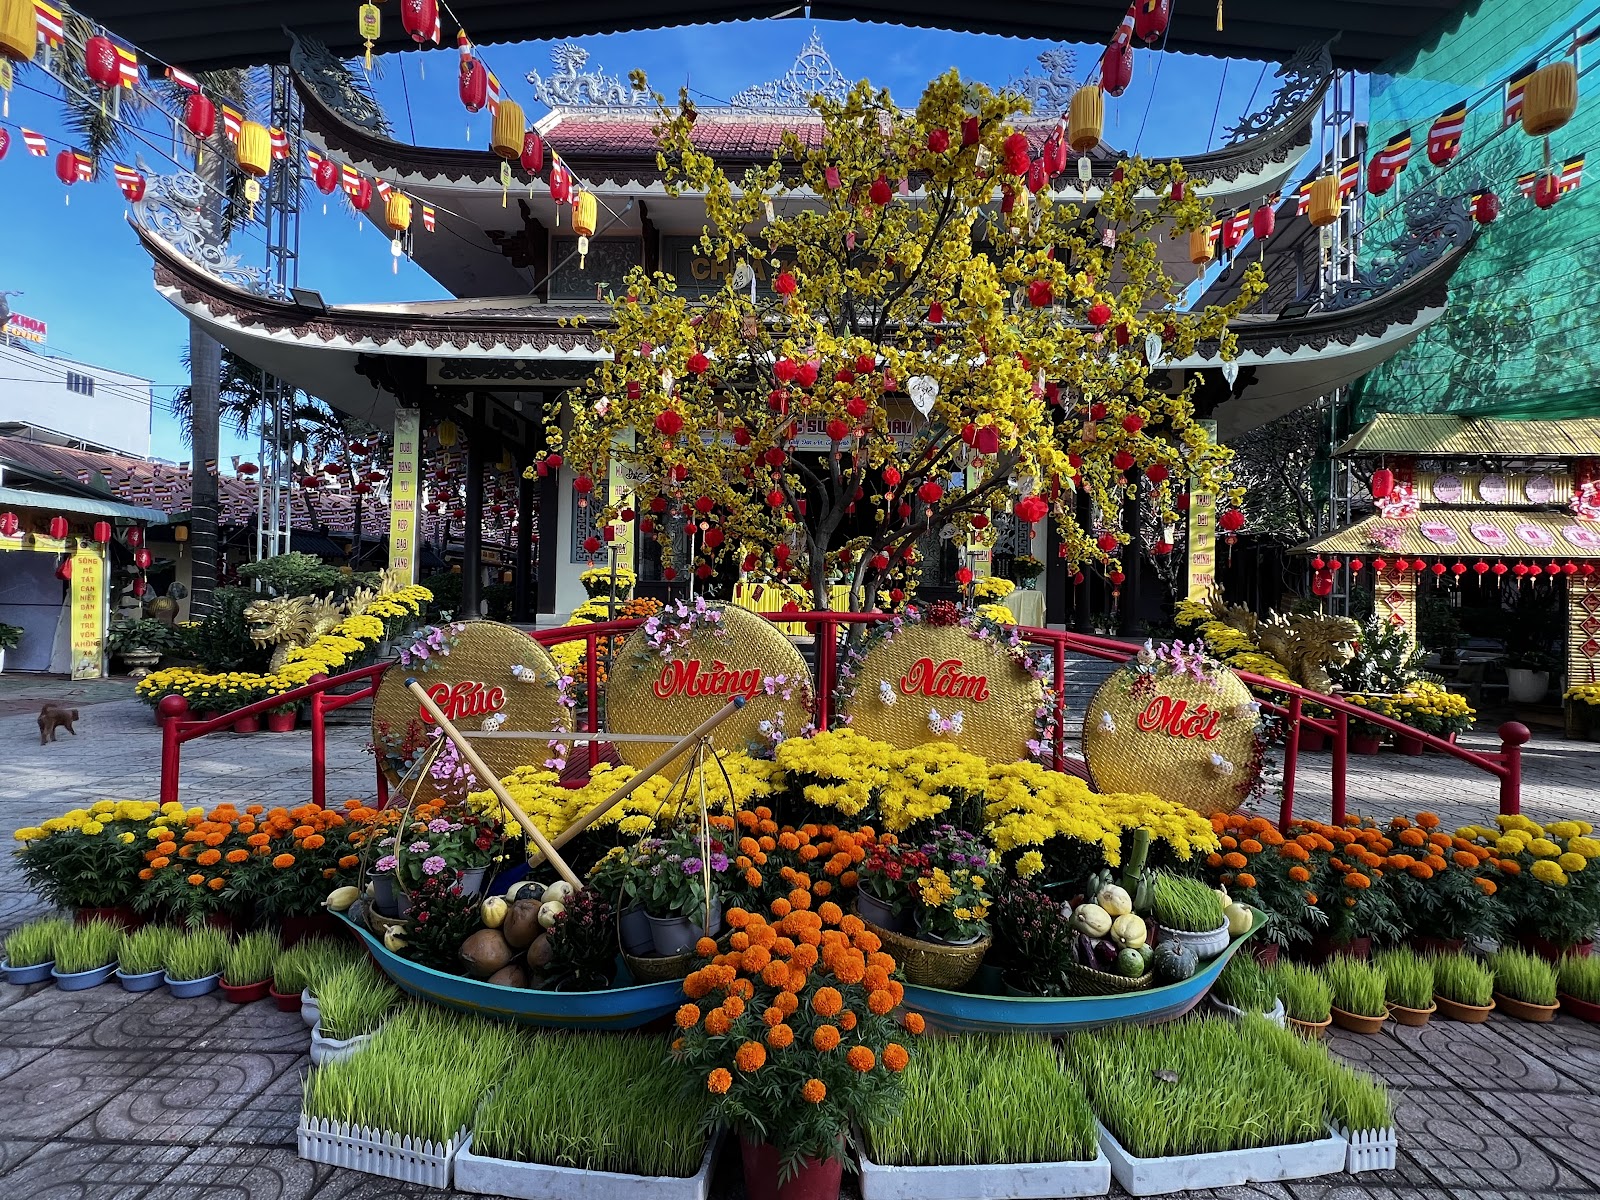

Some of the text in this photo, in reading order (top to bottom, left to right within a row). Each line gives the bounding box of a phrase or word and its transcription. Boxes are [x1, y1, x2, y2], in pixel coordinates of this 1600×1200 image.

[691, 257, 767, 281] CHA
[418, 657, 1222, 741] Chúc Mừng Năm Mới
